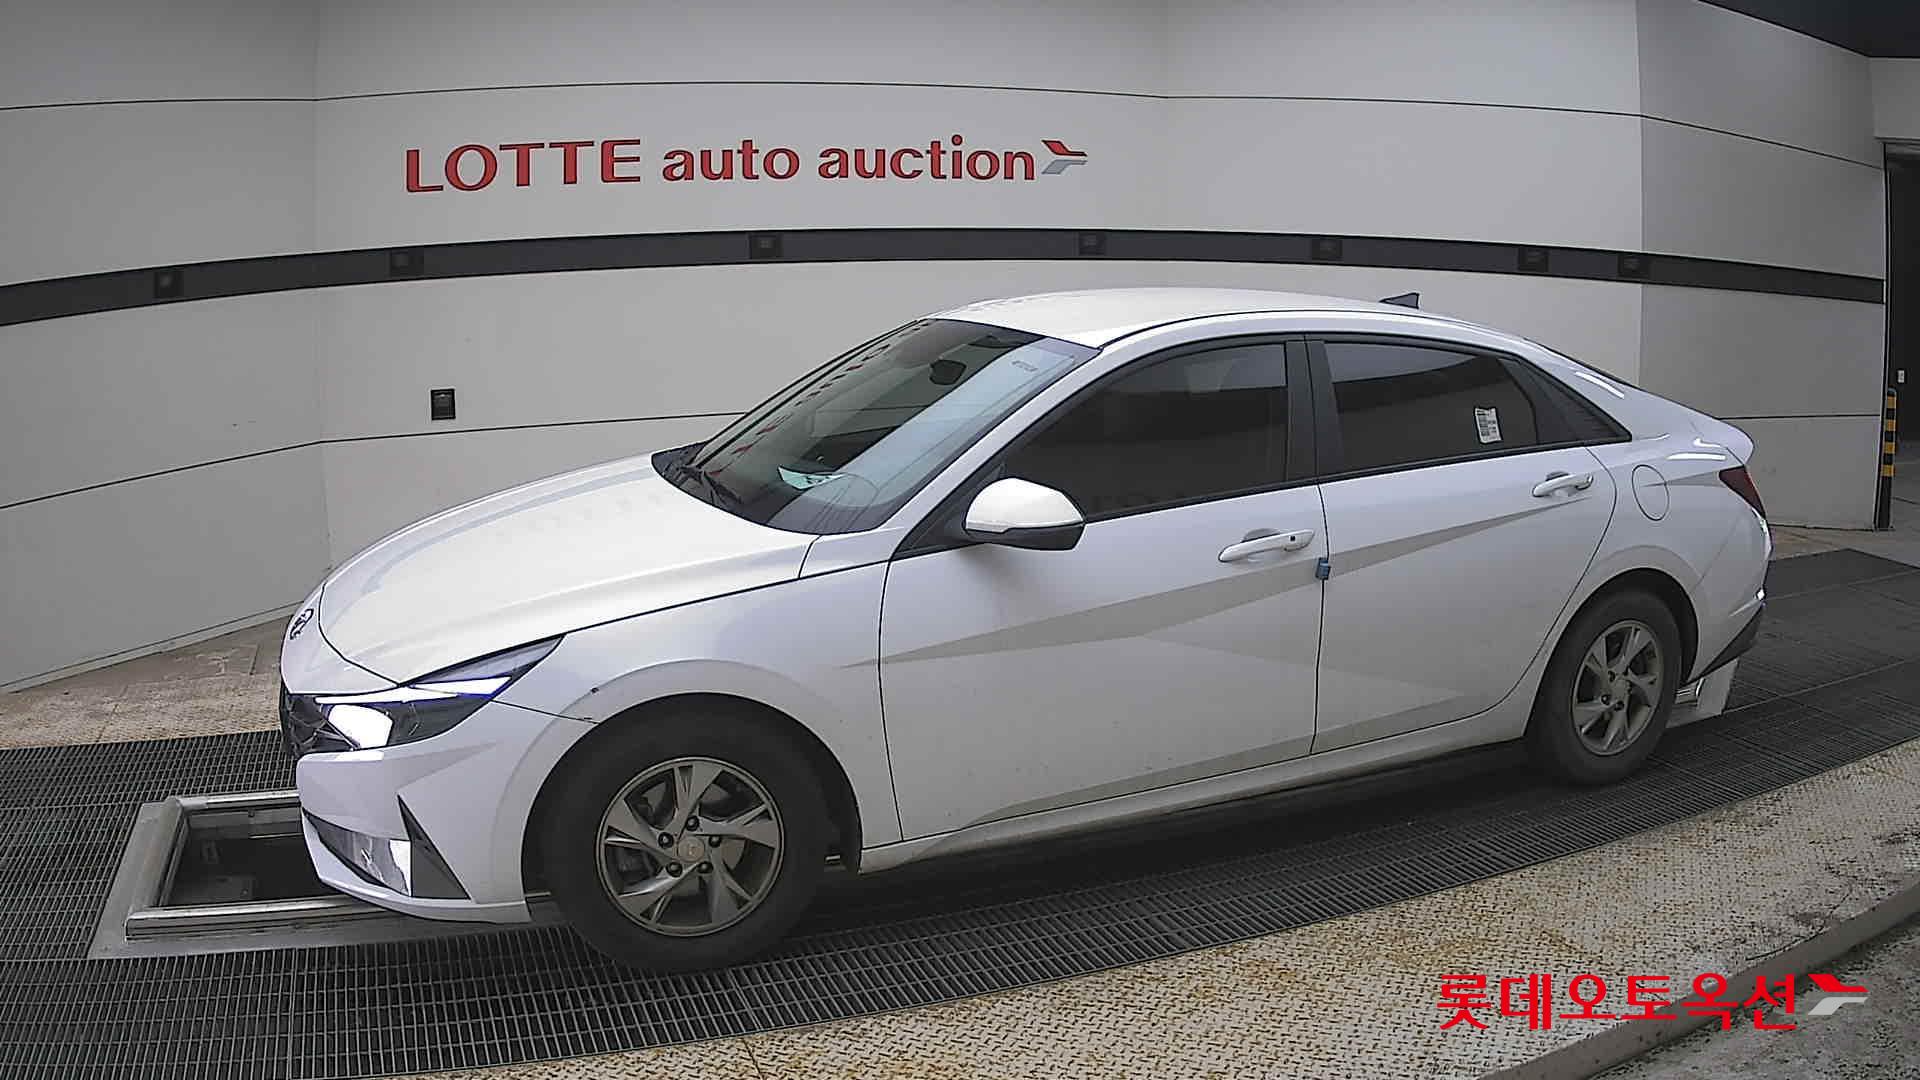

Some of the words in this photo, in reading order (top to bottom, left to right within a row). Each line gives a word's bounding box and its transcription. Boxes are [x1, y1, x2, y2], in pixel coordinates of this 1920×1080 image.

[406, 139, 641, 193] LOTTE
[662, 139, 800, 182] auto
[818, 134, 1035, 181] auction
